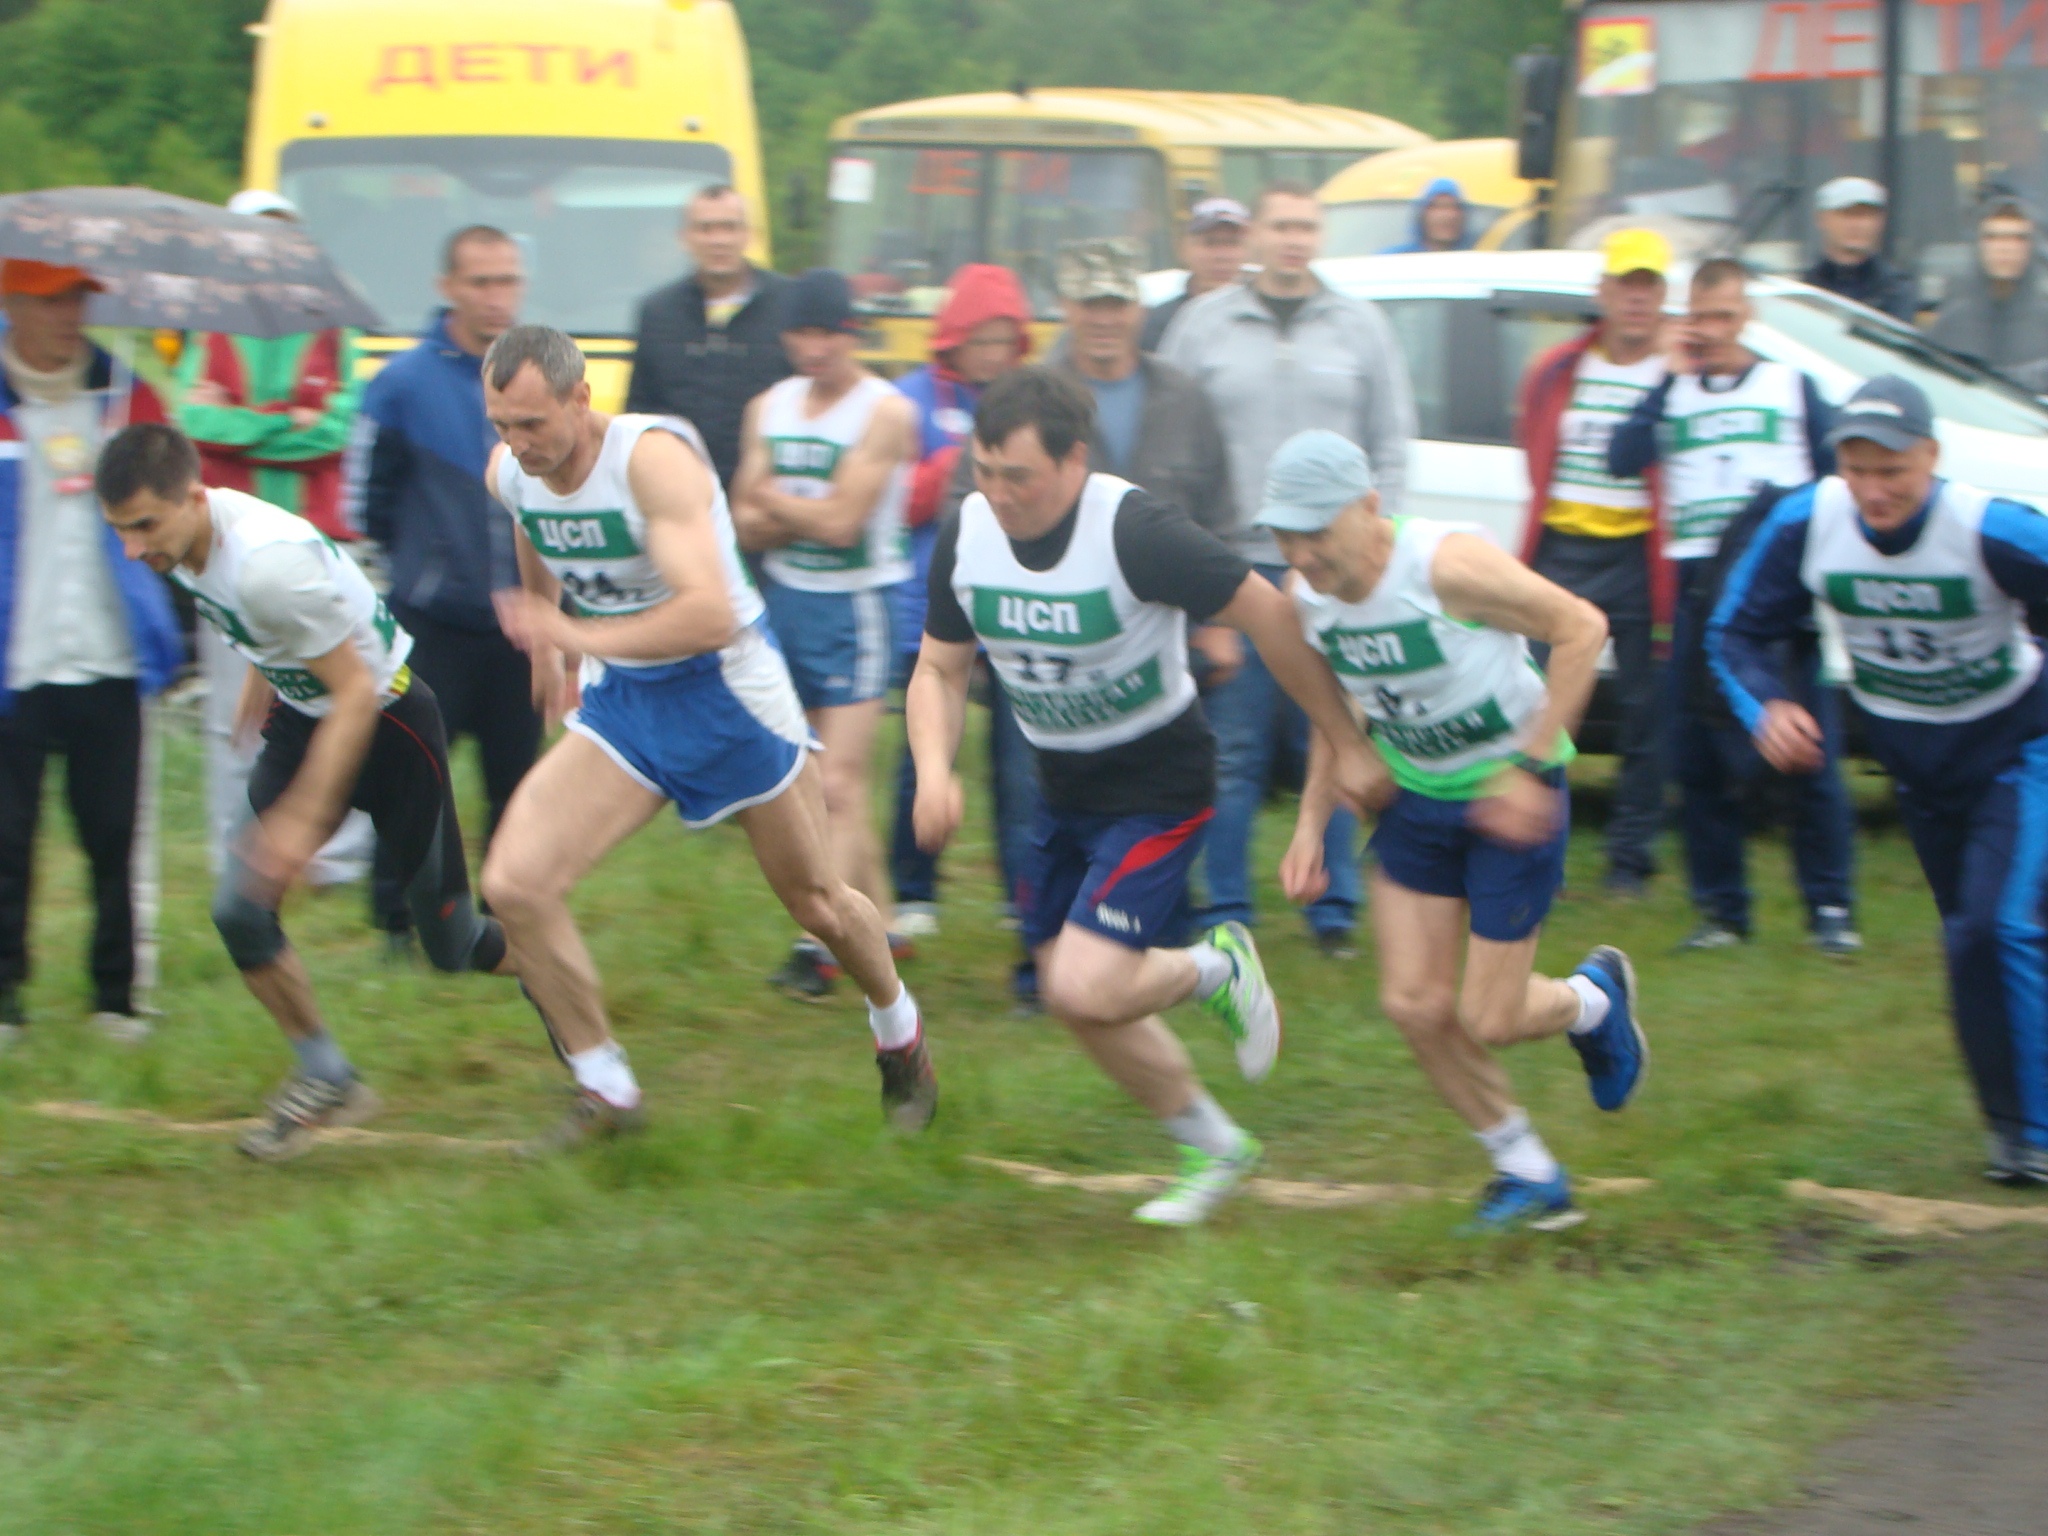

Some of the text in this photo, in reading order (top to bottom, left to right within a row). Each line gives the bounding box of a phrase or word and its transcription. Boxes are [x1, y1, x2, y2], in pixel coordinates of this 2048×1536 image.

[366, 42, 638, 94] ДЕТИ
[537, 518, 607, 552] ЦСП
[999, 595, 1081, 635] ЦСП
[1015, 651, 1072, 684] 17
[1335, 632, 1407, 671] ЦСП
